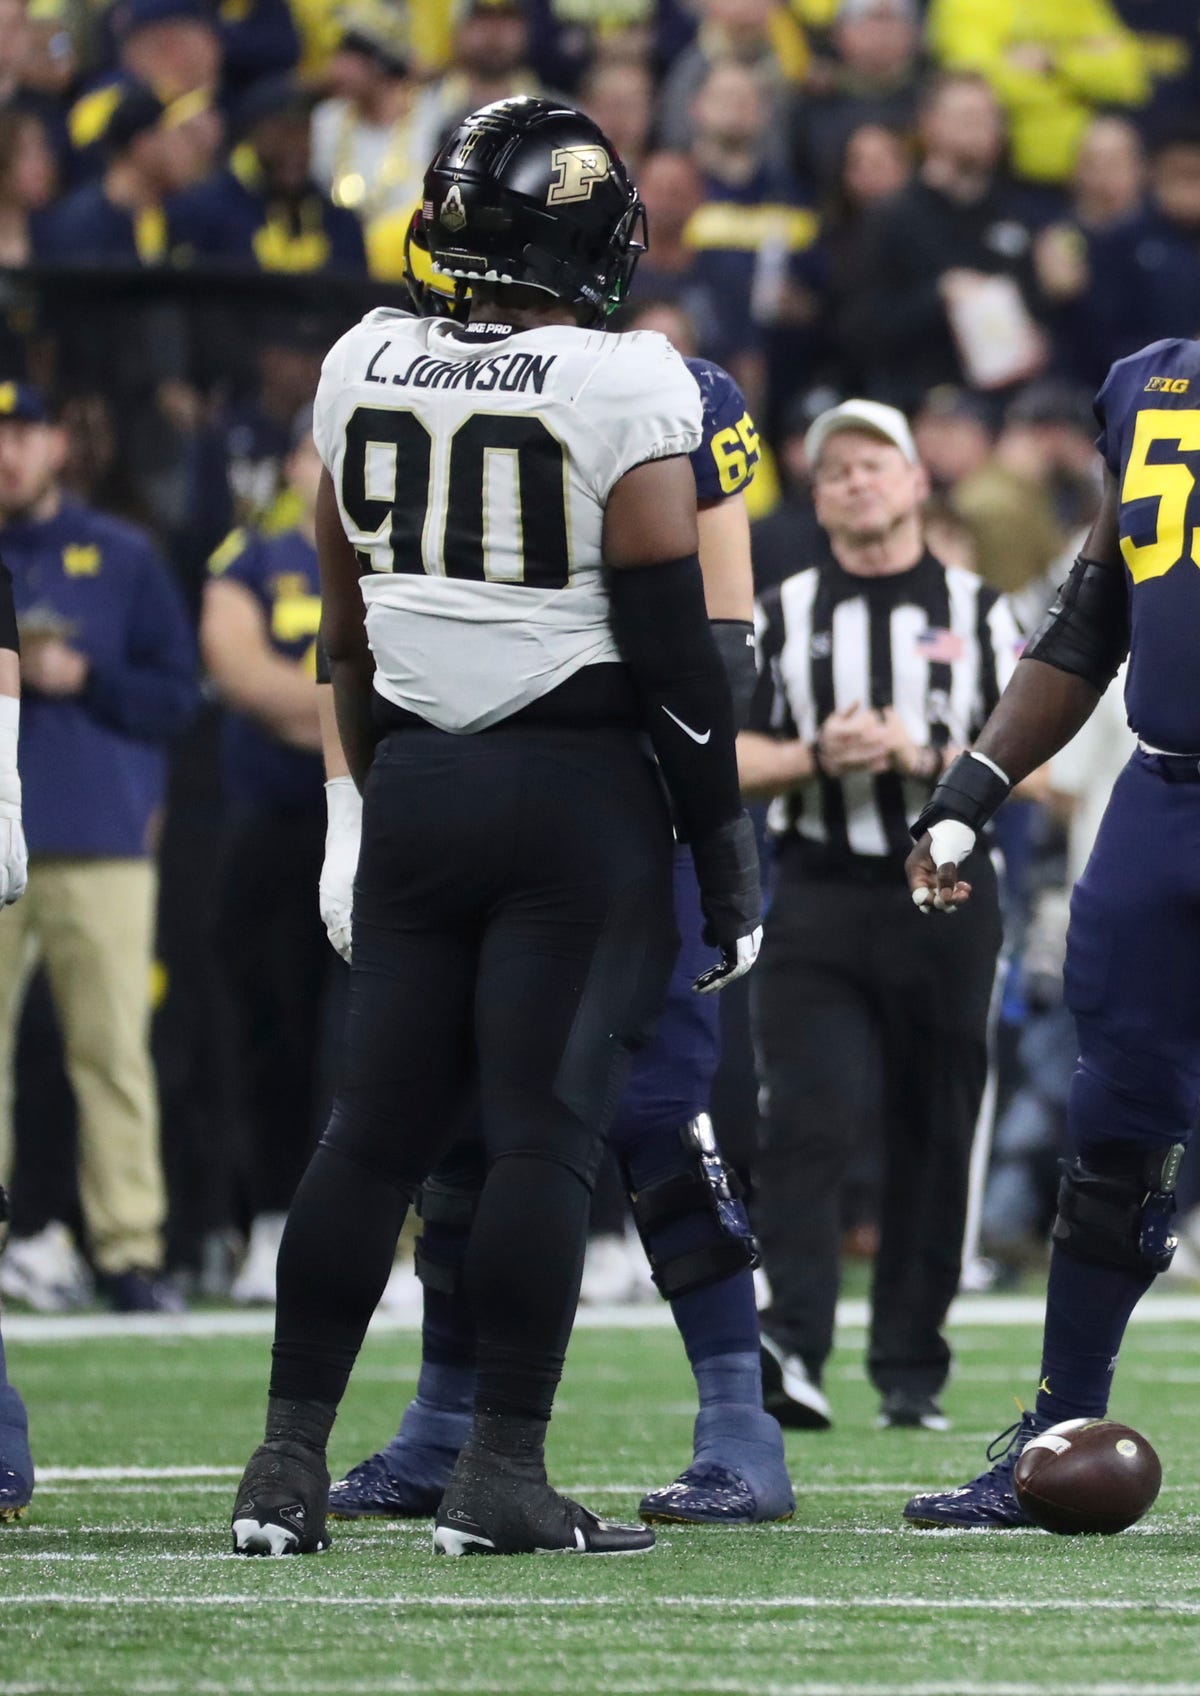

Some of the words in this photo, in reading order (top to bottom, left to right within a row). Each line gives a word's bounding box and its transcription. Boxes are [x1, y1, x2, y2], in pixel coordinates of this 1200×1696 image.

[546, 145, 610, 207] P
[485, 323, 513, 334] PRO
[392, 352, 557, 394] JOHNSON
[341, 403, 570, 590] 90
